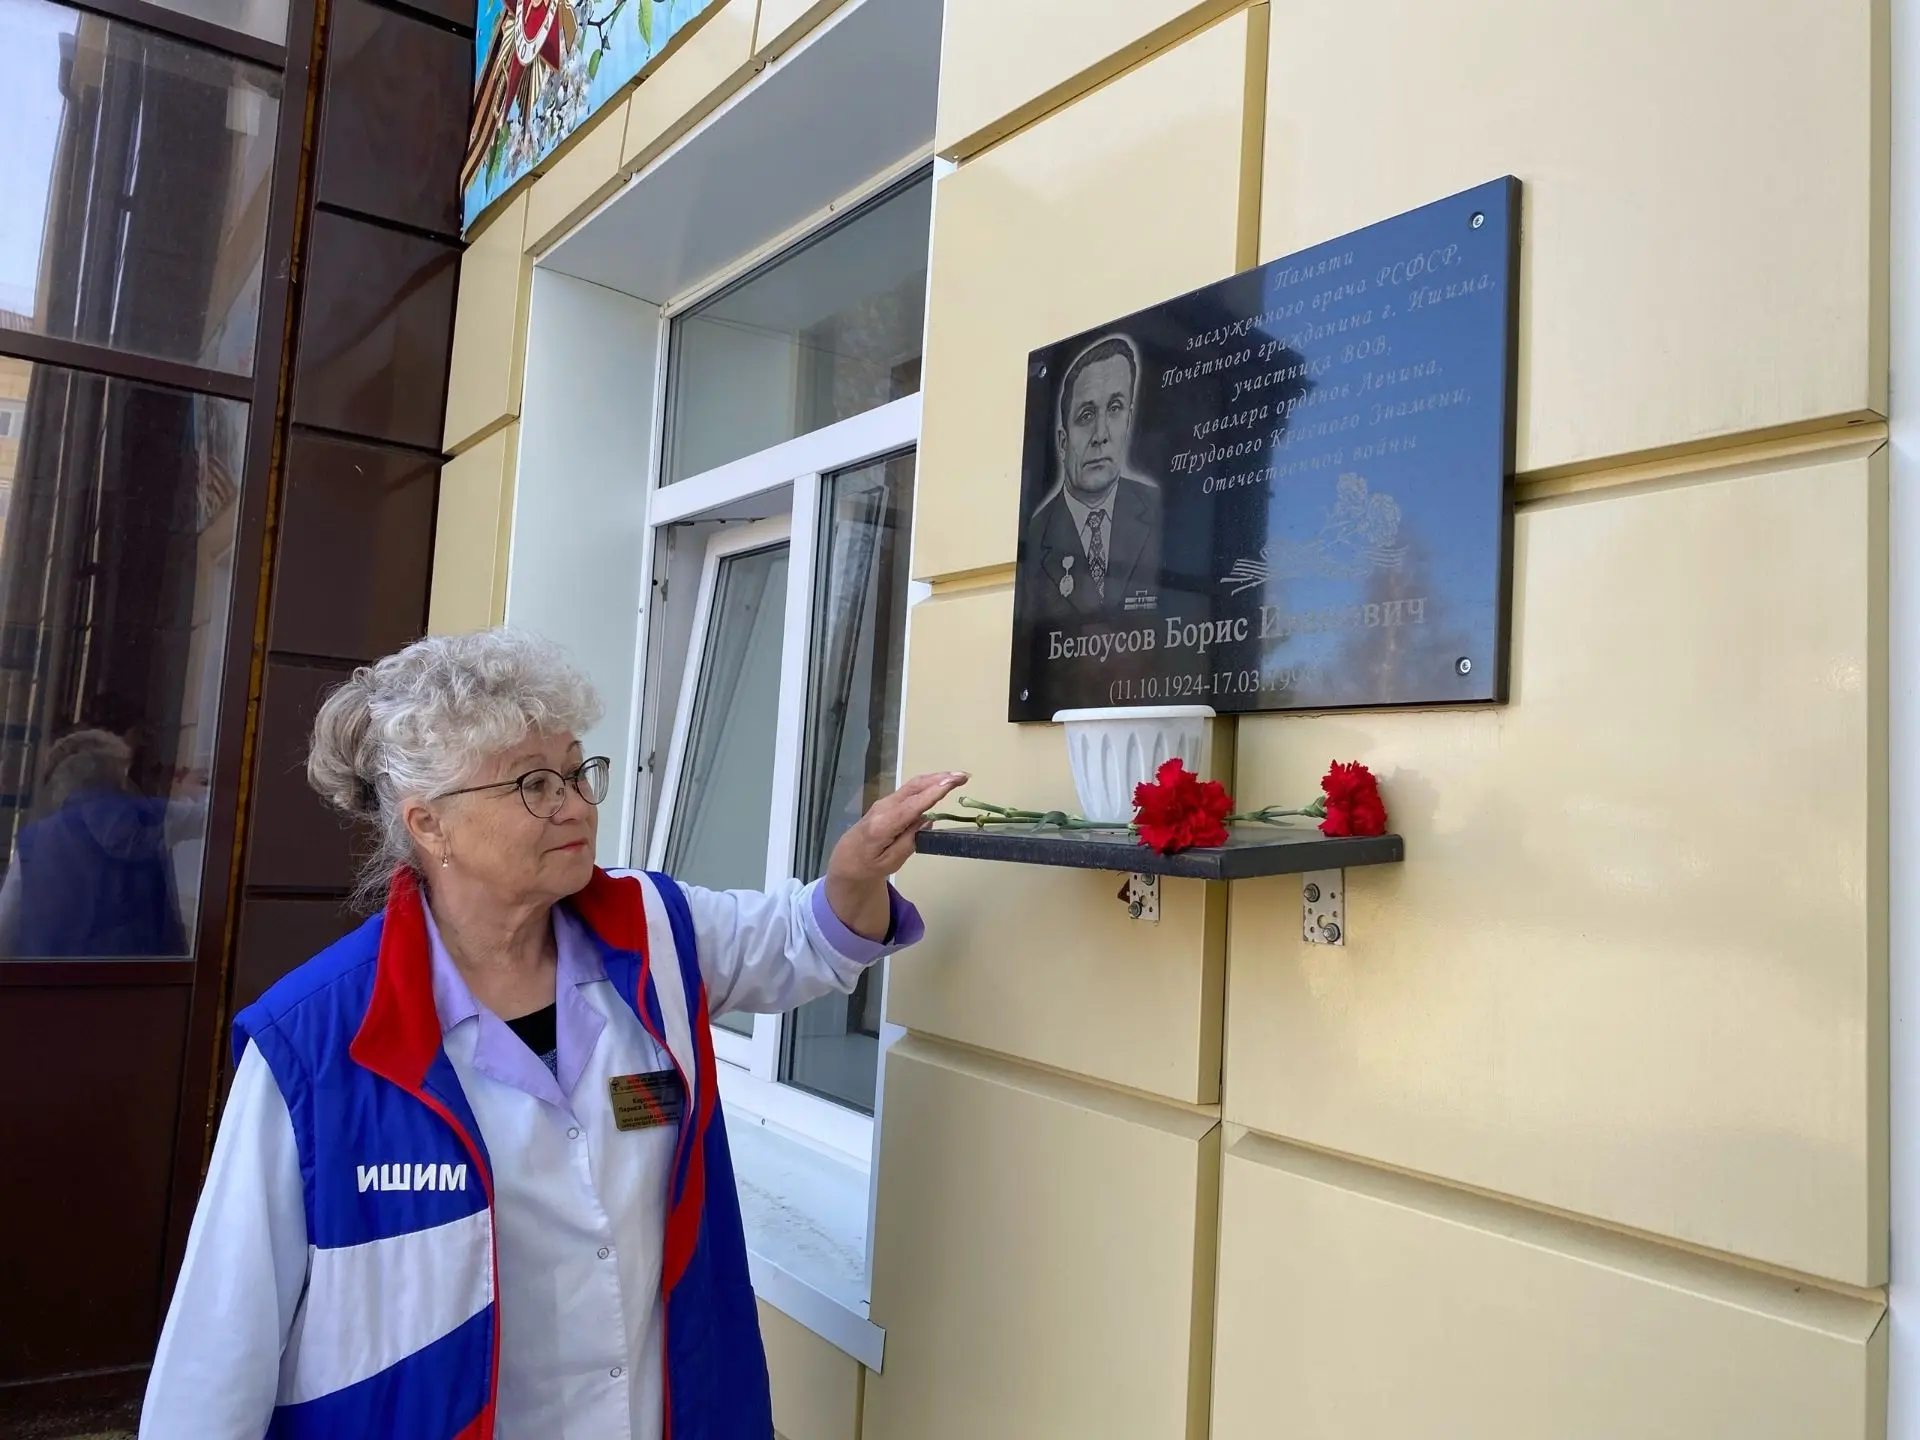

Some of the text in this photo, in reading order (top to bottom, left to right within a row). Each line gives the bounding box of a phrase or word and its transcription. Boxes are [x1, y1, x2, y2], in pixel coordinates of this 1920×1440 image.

[1186, 244, 1462, 351] заслуженного врача РСФСР,
[1274, 251, 1353, 290] Памяти
[1161, 274, 1495, 389] Почётного гражданина г. Ишима,
[1193, 360, 1443, 440] кавалера орденов Ленина,
[1232, 335, 1393, 402] участника ВОВ,
[1170, 438, 1262, 473] Трудового
[1369, 388, 1471, 426] Знамени,
[1048, 628, 1155, 663] Белоусов
[1164, 616, 1248, 654] Борис
[357, 1163, 467, 1192] ИШИМ
